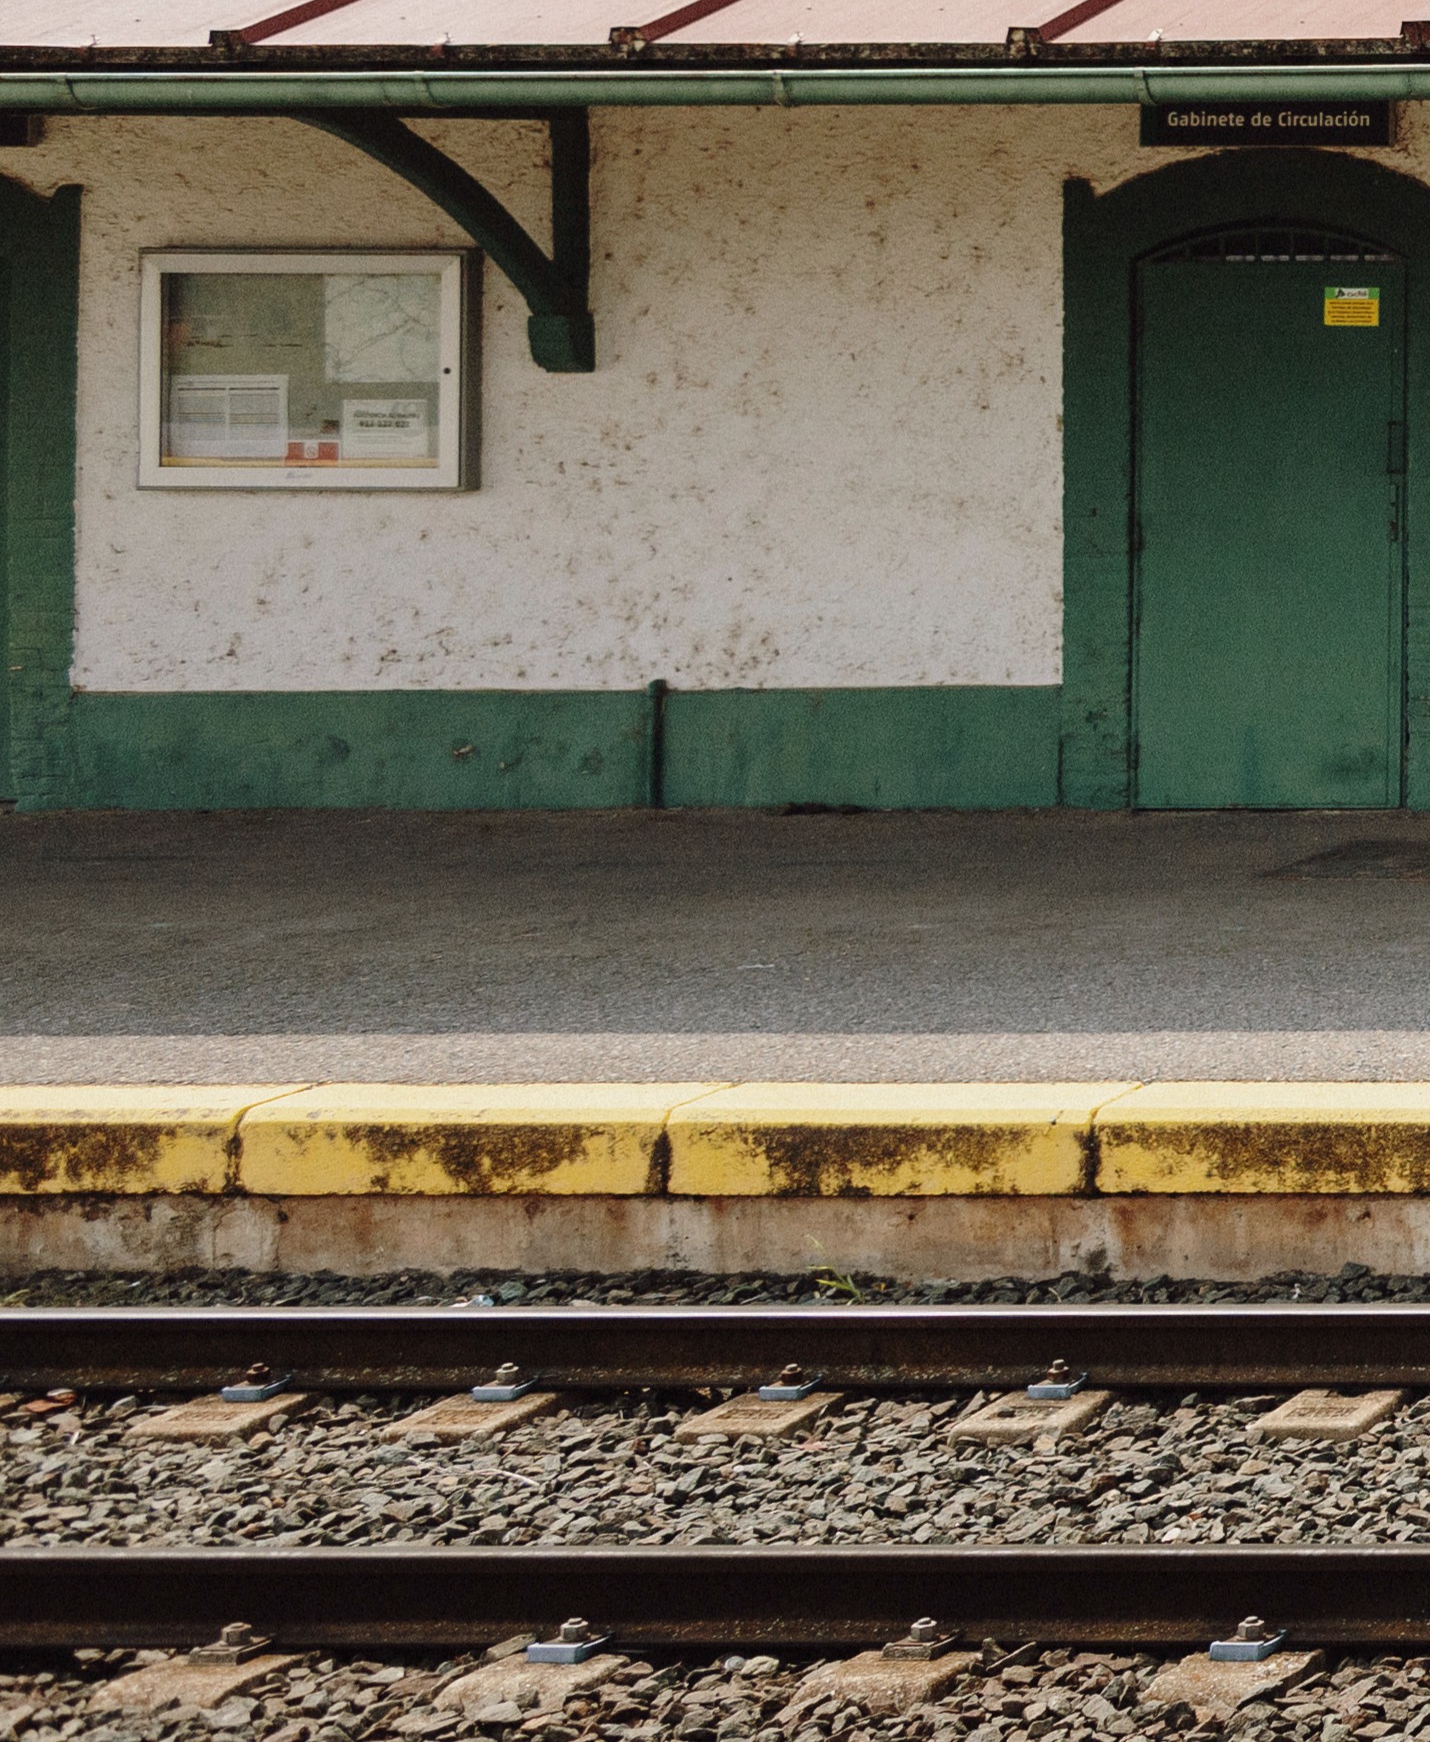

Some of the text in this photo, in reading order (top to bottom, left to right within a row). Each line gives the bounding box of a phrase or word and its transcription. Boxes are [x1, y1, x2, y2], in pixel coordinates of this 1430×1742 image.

[1167, 110, 1371, 127] Gabinete de Circulación
